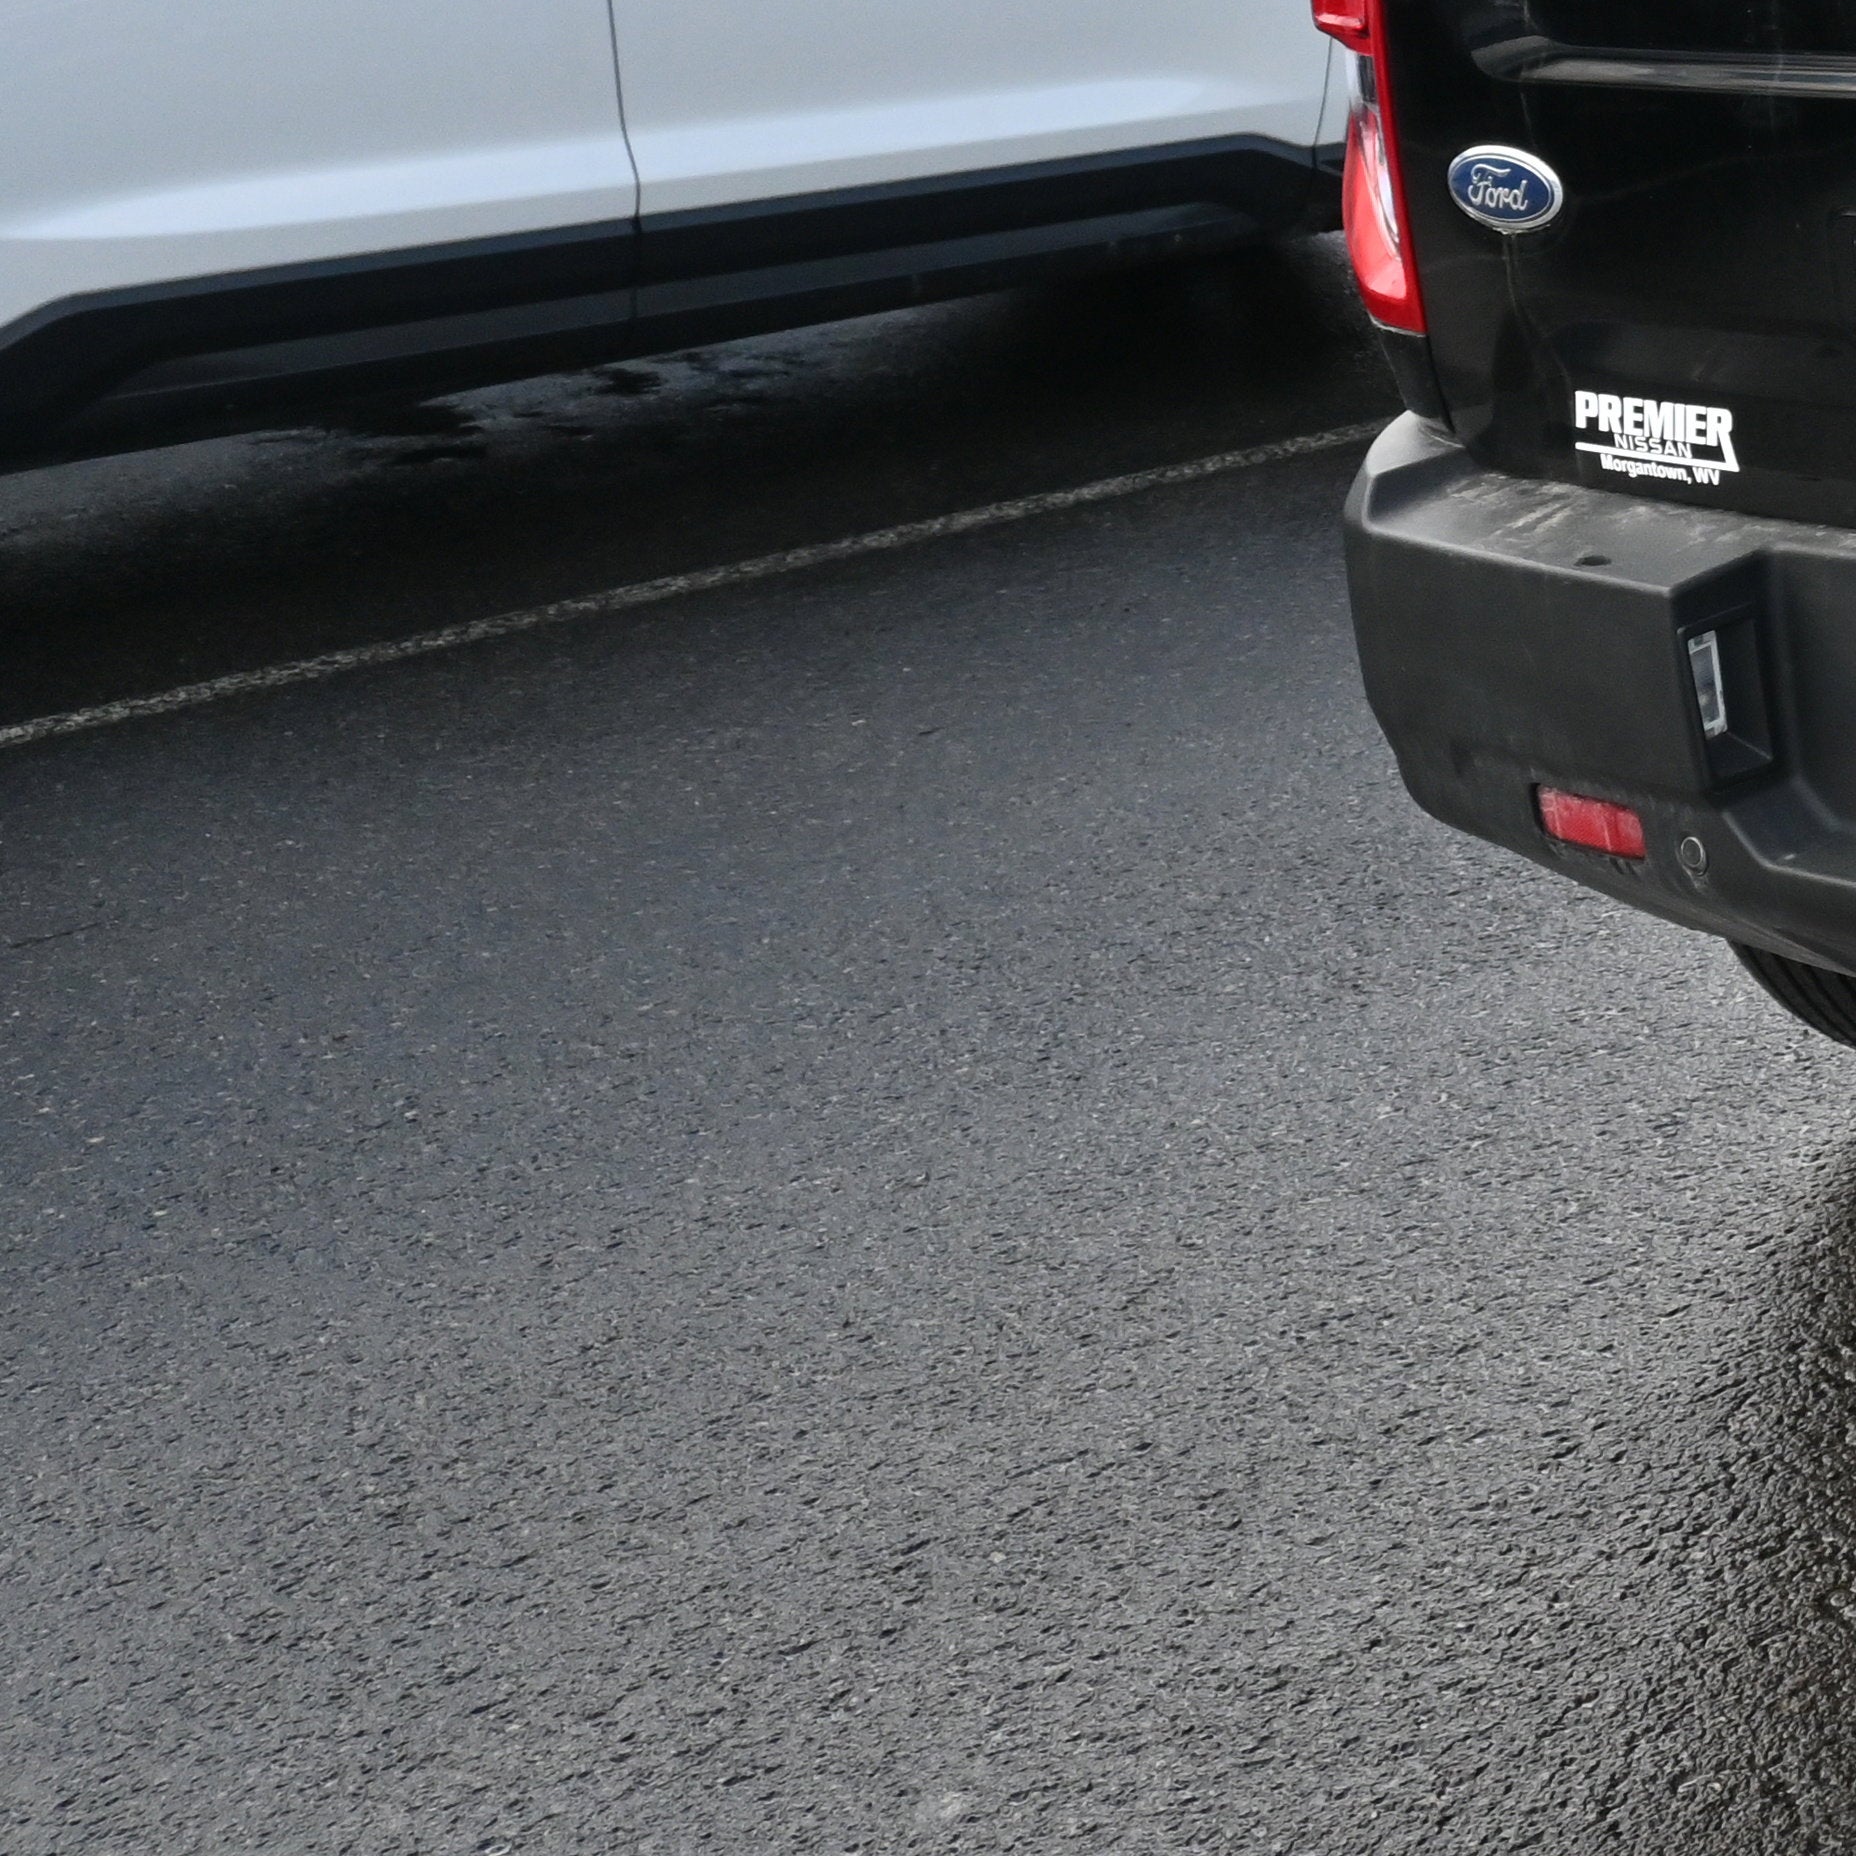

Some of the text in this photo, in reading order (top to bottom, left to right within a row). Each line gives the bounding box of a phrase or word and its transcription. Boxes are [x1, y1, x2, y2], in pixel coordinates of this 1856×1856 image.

[1468, 163, 1529, 211] Ford
[1575, 390, 1735, 456] PREMIER
[1614, 433, 1692, 459] NISSAN
[1600, 452, 1721, 486] Morgantown, WV
